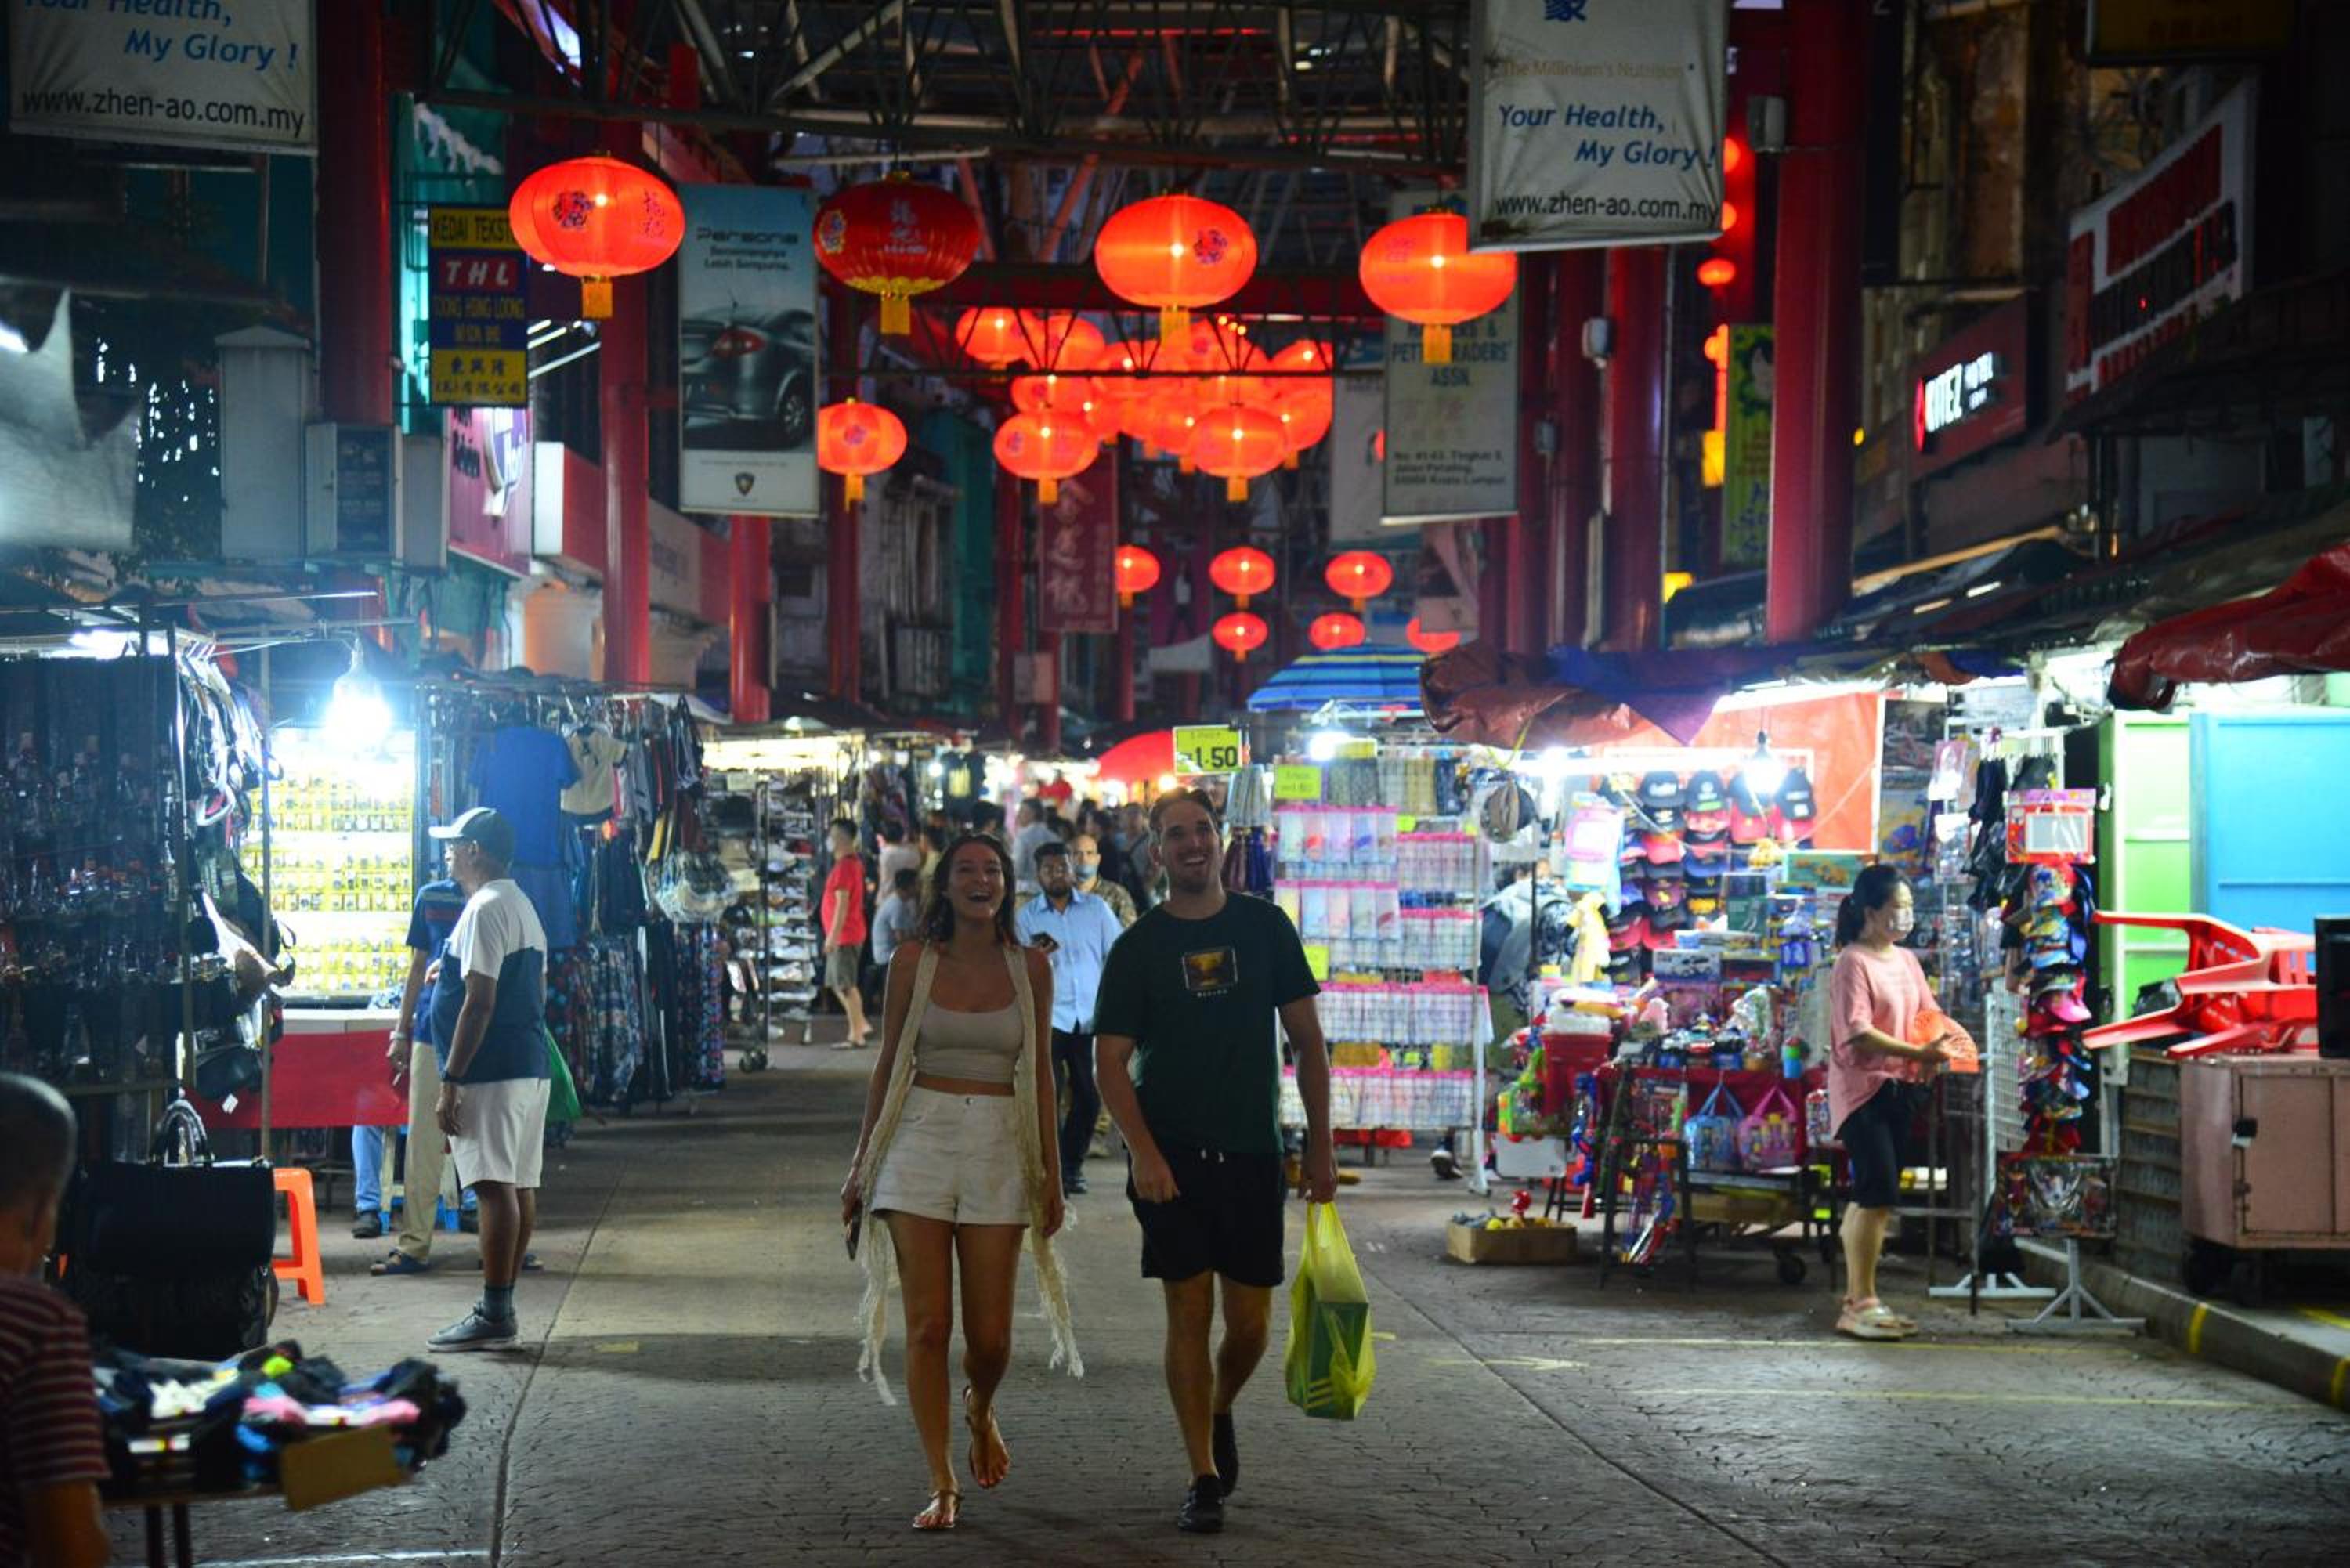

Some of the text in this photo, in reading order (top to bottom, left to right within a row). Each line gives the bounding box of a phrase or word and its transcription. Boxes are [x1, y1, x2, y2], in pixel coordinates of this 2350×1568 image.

[123, 28, 172, 63] My
[183, 33, 277, 71] Glory
[22, 88, 306, 138] www.zhen-ao.com.my
[1499, 103, 1665, 134] Your Health,
[1574, 139, 1615, 168] My
[1623, 139, 1700, 172] Glory
[1495, 190, 1721, 227] www.zhen-ao.com.my
[433, 215, 468, 241] KEDAI
[696, 226, 798, 244] Persona
[1430, 475, 1460, 485] Kuala
